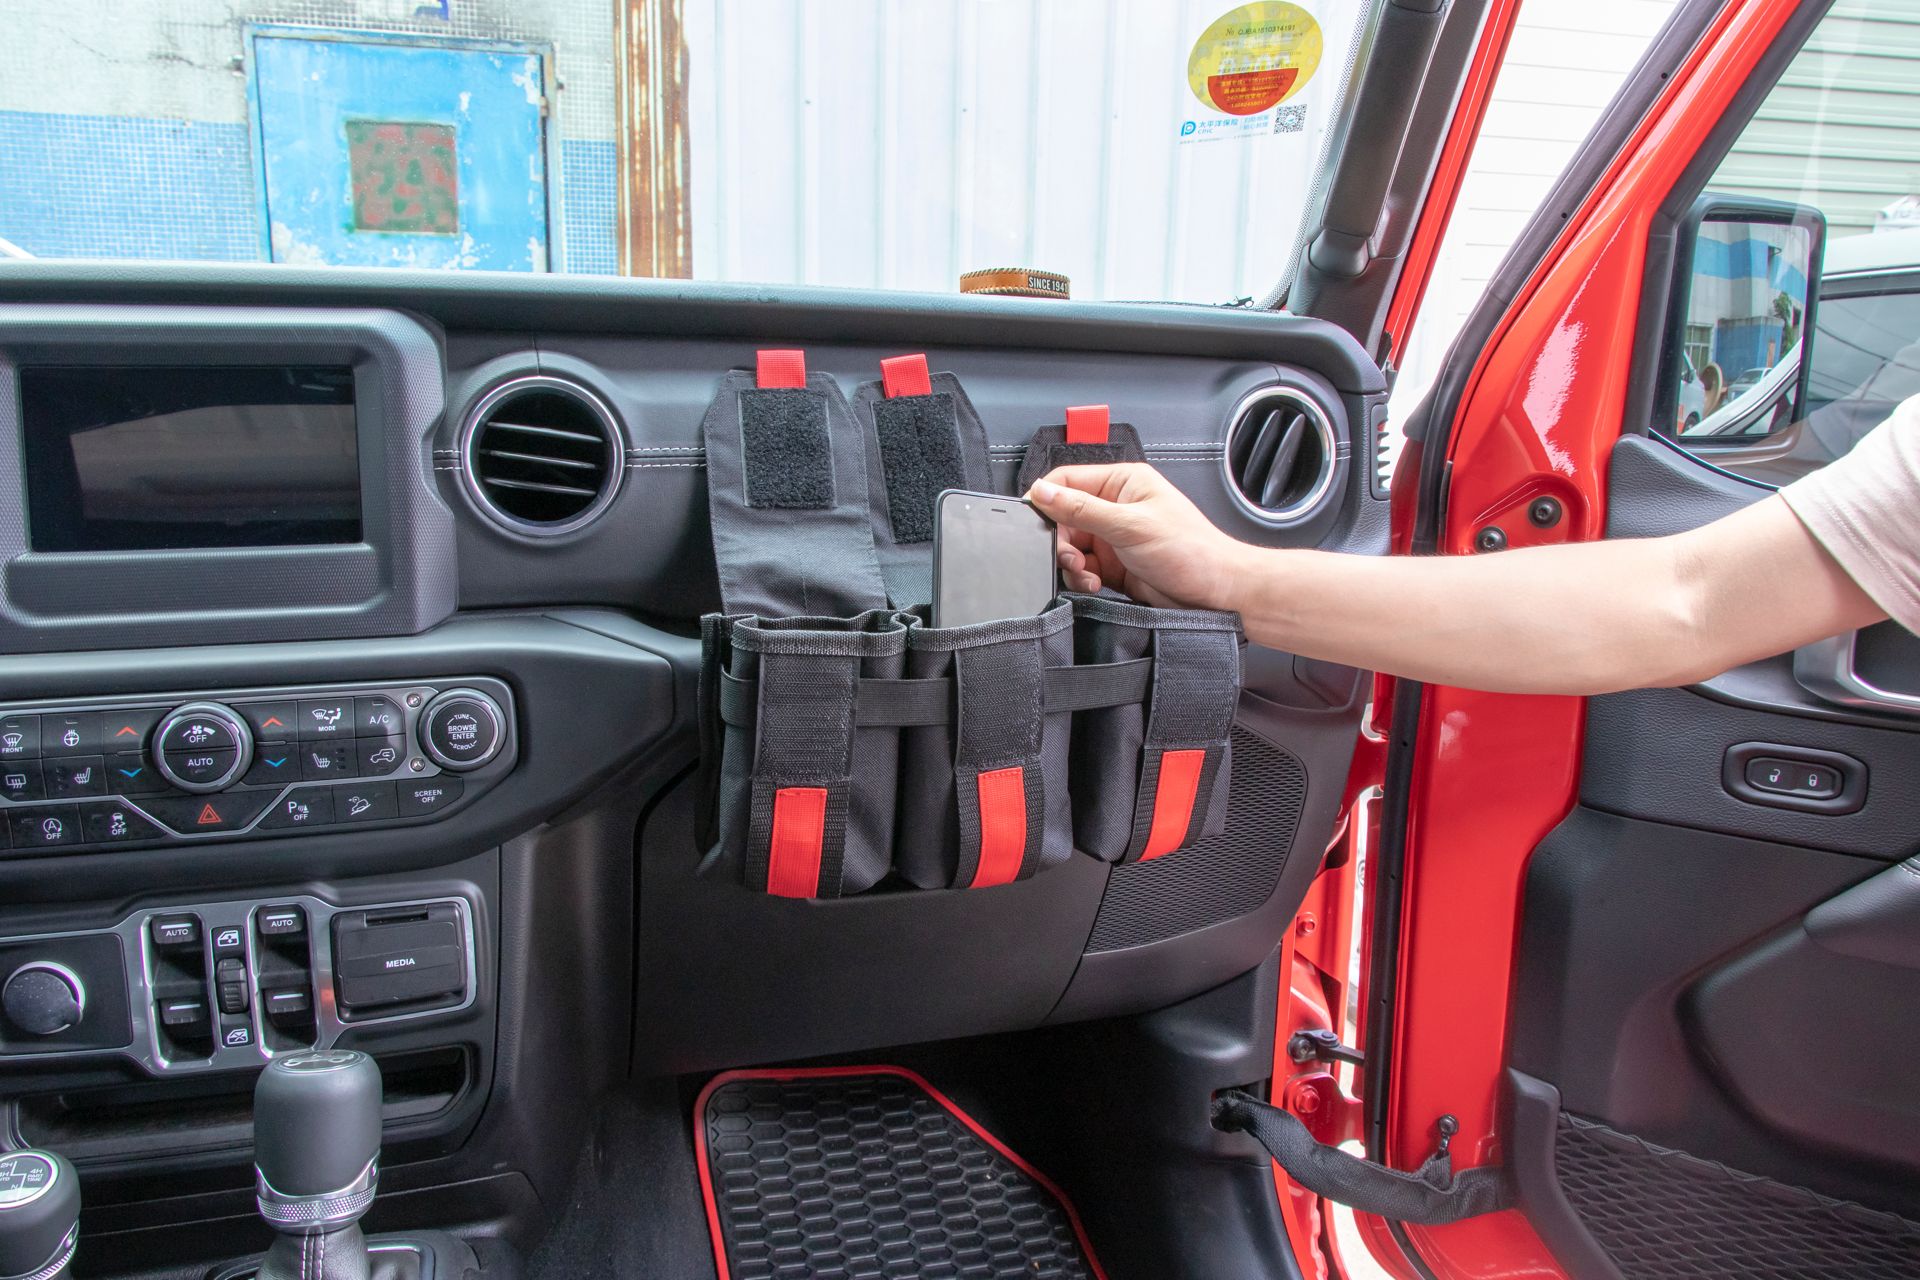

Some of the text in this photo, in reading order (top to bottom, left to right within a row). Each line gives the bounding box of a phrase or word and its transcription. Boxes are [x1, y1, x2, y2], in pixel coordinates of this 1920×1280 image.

[1028, 276, 1051, 290] SINCE
[369, 714, 390, 725] A/C
[189, 735, 207, 743] OFF
[452, 732, 475, 740] ENTER
[453, 742, 475, 750] SCROLL
[188, 758, 213, 767] AUTO
[414, 789, 442, 798] SCREEN
[293, 813, 308, 821] OFF
[46, 832, 61, 840] OFF
[111, 828, 127, 836] OFF
[271, 918, 293, 928] AUTO
[165, 927, 189, 937] AUTO
[385, 957, 415, 968] MEDIA
